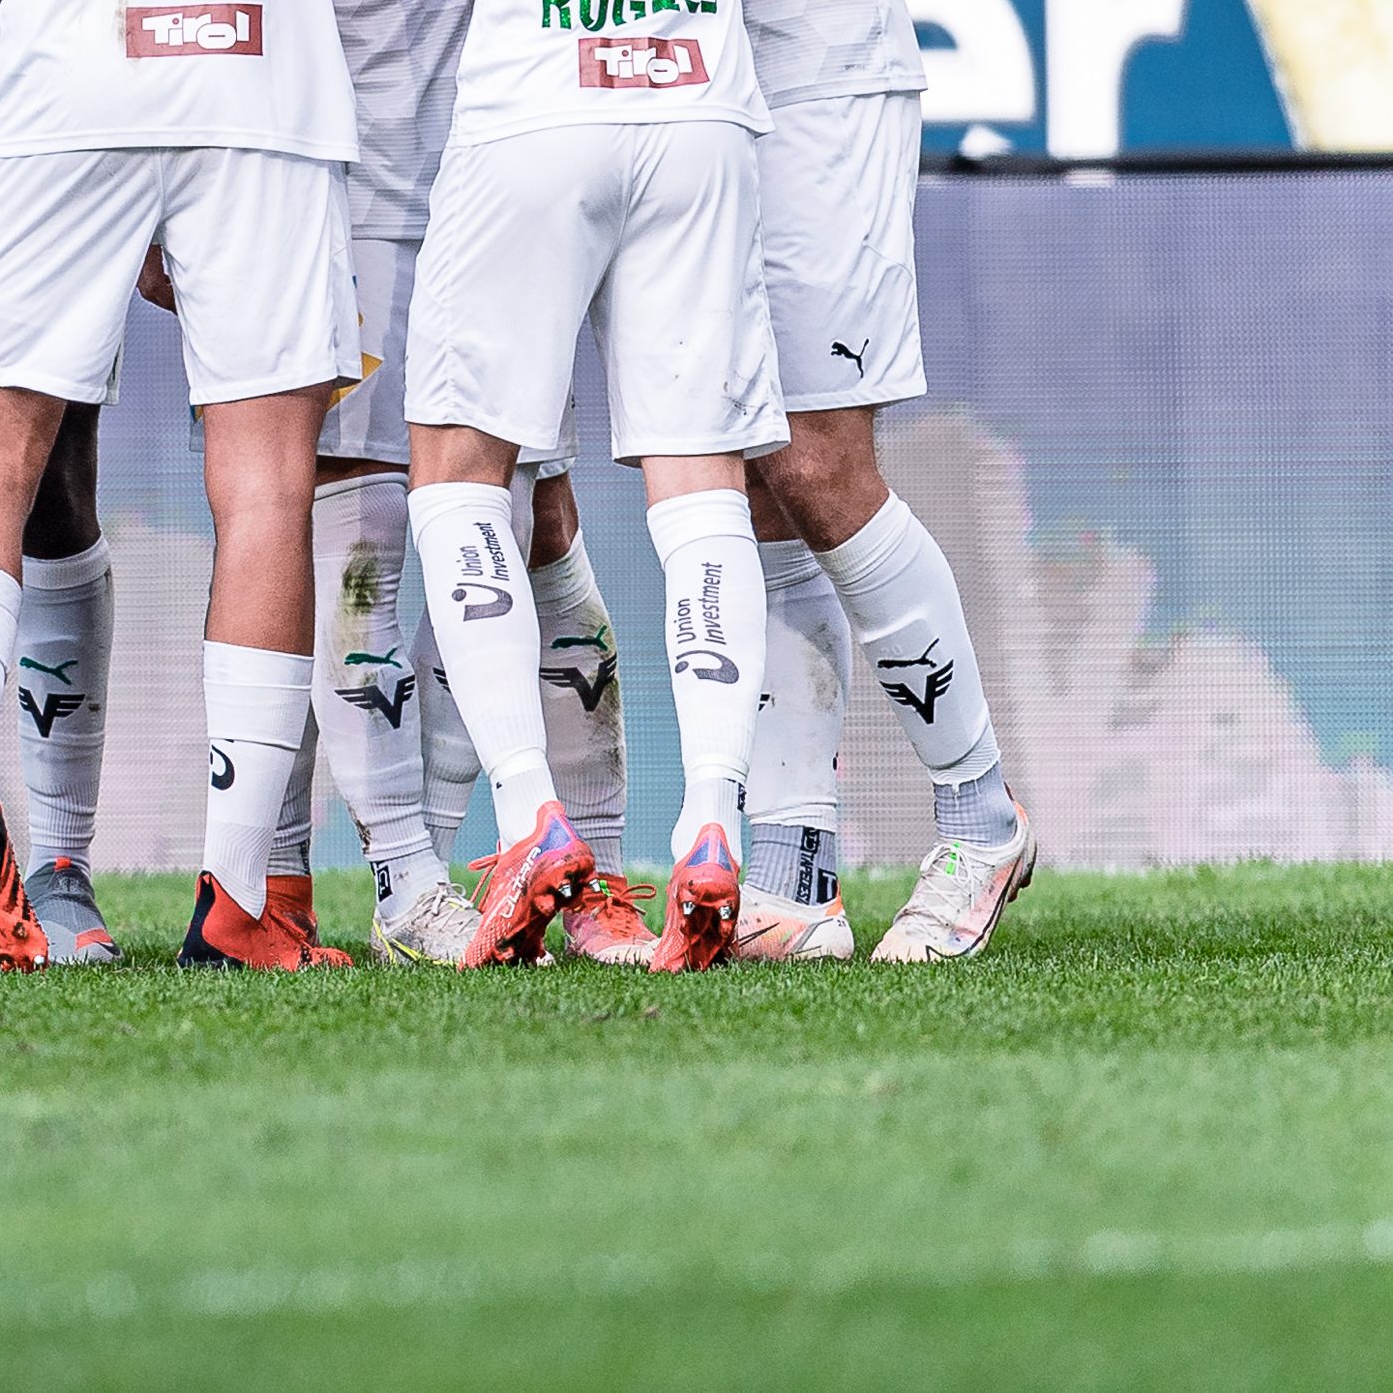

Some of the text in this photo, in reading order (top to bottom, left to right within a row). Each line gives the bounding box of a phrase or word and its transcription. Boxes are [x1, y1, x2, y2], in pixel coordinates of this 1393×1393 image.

[141, 10, 251, 50] Tirol
[594, 45, 693, 85] Tirol
[459, 545, 483, 577] Union
[473, 522, 510, 582] Investment
[675, 598, 697, 645] Union
[696, 561, 727, 646] Investment
